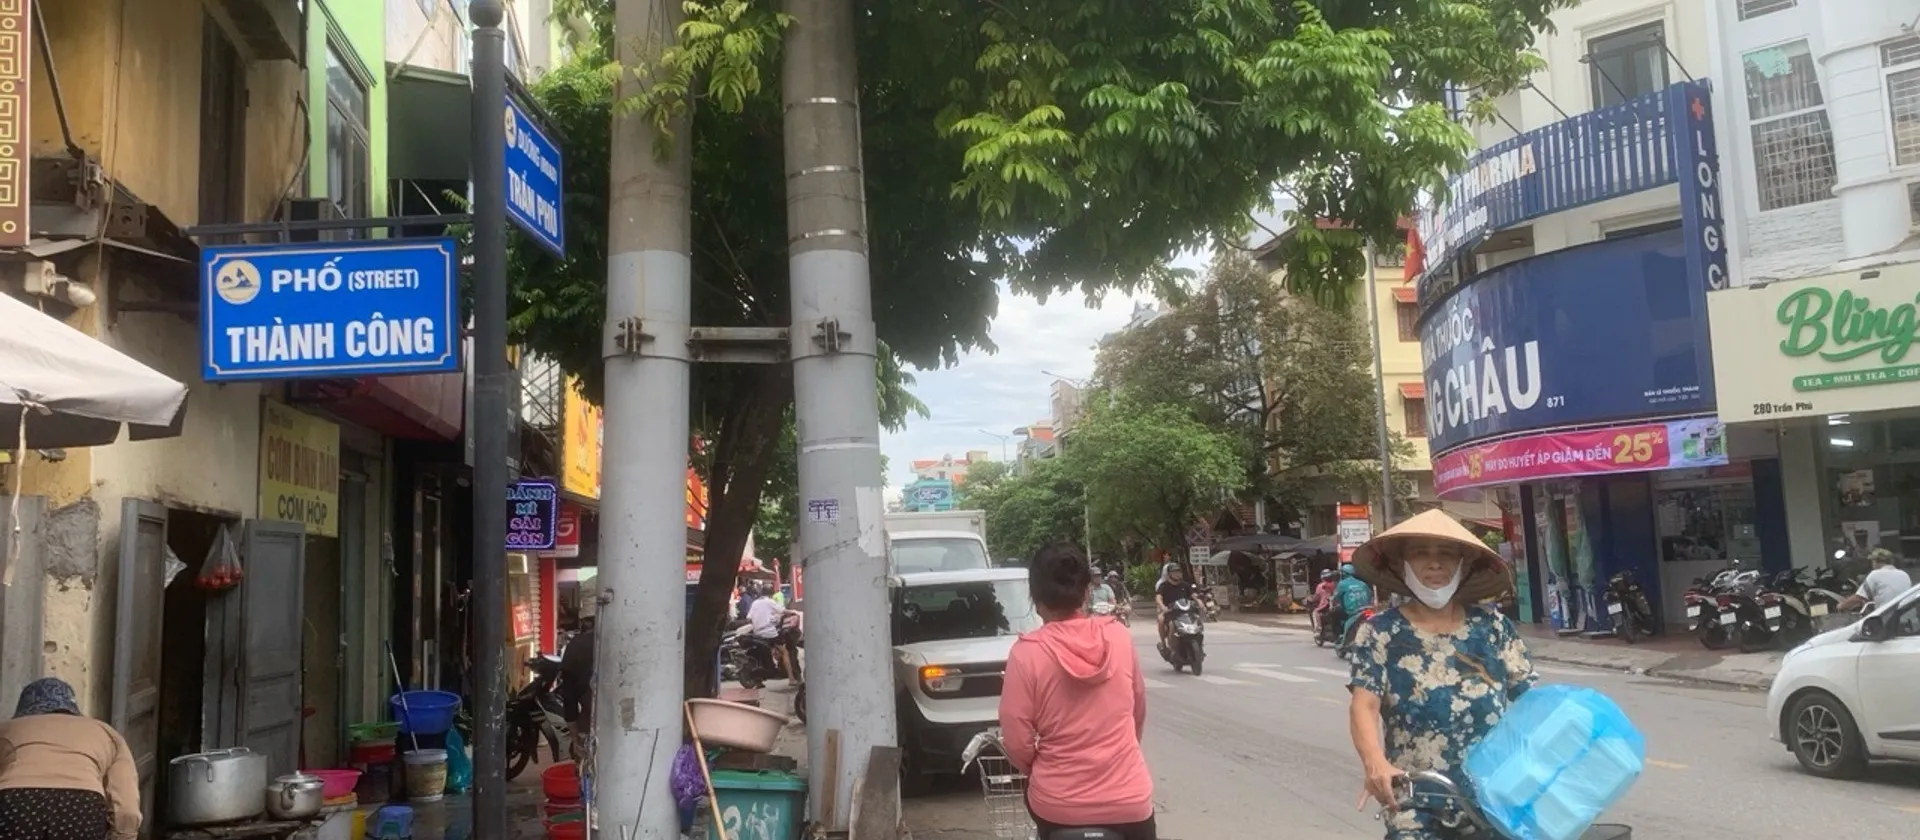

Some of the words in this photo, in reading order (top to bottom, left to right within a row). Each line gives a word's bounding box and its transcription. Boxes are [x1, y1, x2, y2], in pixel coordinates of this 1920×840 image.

[508, 167, 536, 221] TRẦN
[536, 193, 558, 238] PHÚ
[1697, 130, 1719, 252] LONG
[271, 257, 343, 293] PHỐ
[348, 268, 419, 292] (STREET)
[226, 316, 335, 363] THÀNH
[345, 311, 435, 358] CÔNG
[1445, 335, 1541, 428] CHÂU
[1802, 378, 1822, 387] TEA
[1833, 375, 1861, 384] MILK
[1865, 371, 1887, 381] TEA
[1546, 395, 1565, 408] 871
[1753, 403, 1771, 415] 280
[1796, 401, 1813, 411] Phú
[1509, 449, 1535, 469] HUYẾT
[1537, 450, 1550, 465] ÁP
[1552, 446, 1584, 463] GIẢM
[1586, 442, 1612, 461] ĐẾN
[1613, 431, 1663, 464] 25%
[278, 493, 304, 520] CƠM
[306, 495, 328, 532] HỘP
[510, 515, 541, 531] SÀI
[515, 501, 538, 516] MÌ
[506, 530, 545, 545] GÒN
